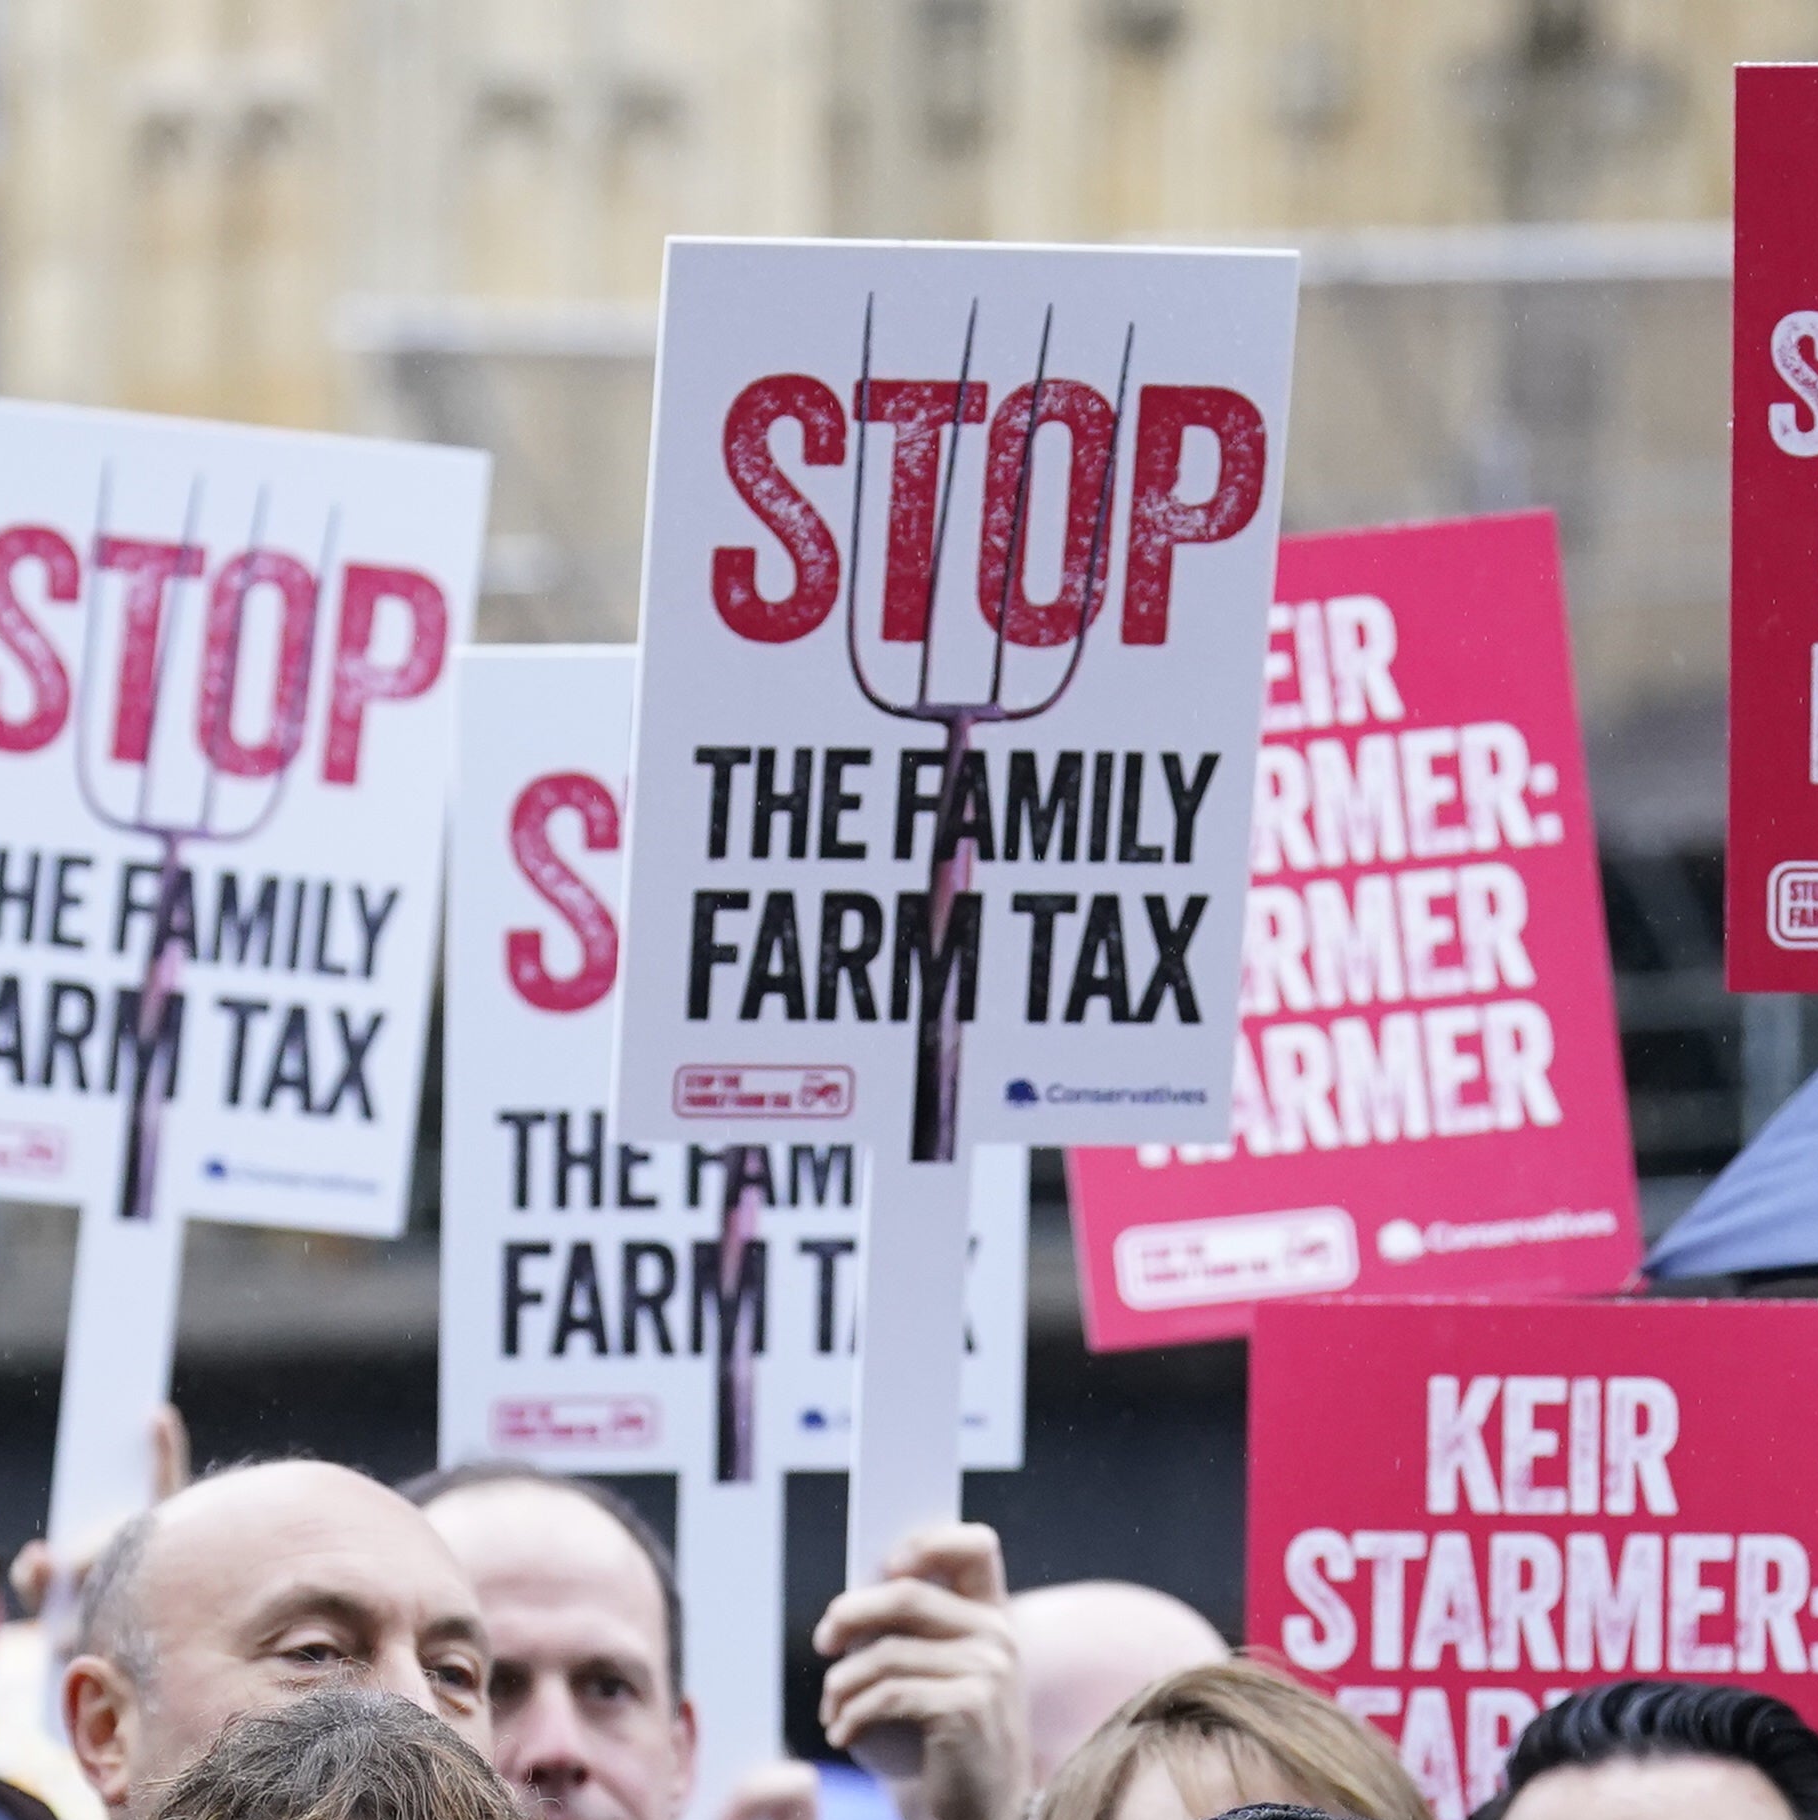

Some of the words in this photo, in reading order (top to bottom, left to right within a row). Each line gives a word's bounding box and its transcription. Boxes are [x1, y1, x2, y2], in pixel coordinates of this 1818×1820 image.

[711, 372, 1267, 647] STOP
[1261, 593, 1405, 734] EIR
[694, 747, 873, 859] THE
[893, 749, 1221, 863] FAMILY
[1248, 721, 1565, 875] RMER:
[112, 856, 401, 980] FAMILY
[687, 889, 984, 1022] FARM
[1012, 893, 1209, 1024] TAX
[1239, 861, 1536, 1017] RMER
[213, 995, 386, 1121] TAX
[497, 1110, 658, 1209] THE
[500, 1239, 767, 1357] FARM
[1425, 1373, 1679, 1516] KEIR
